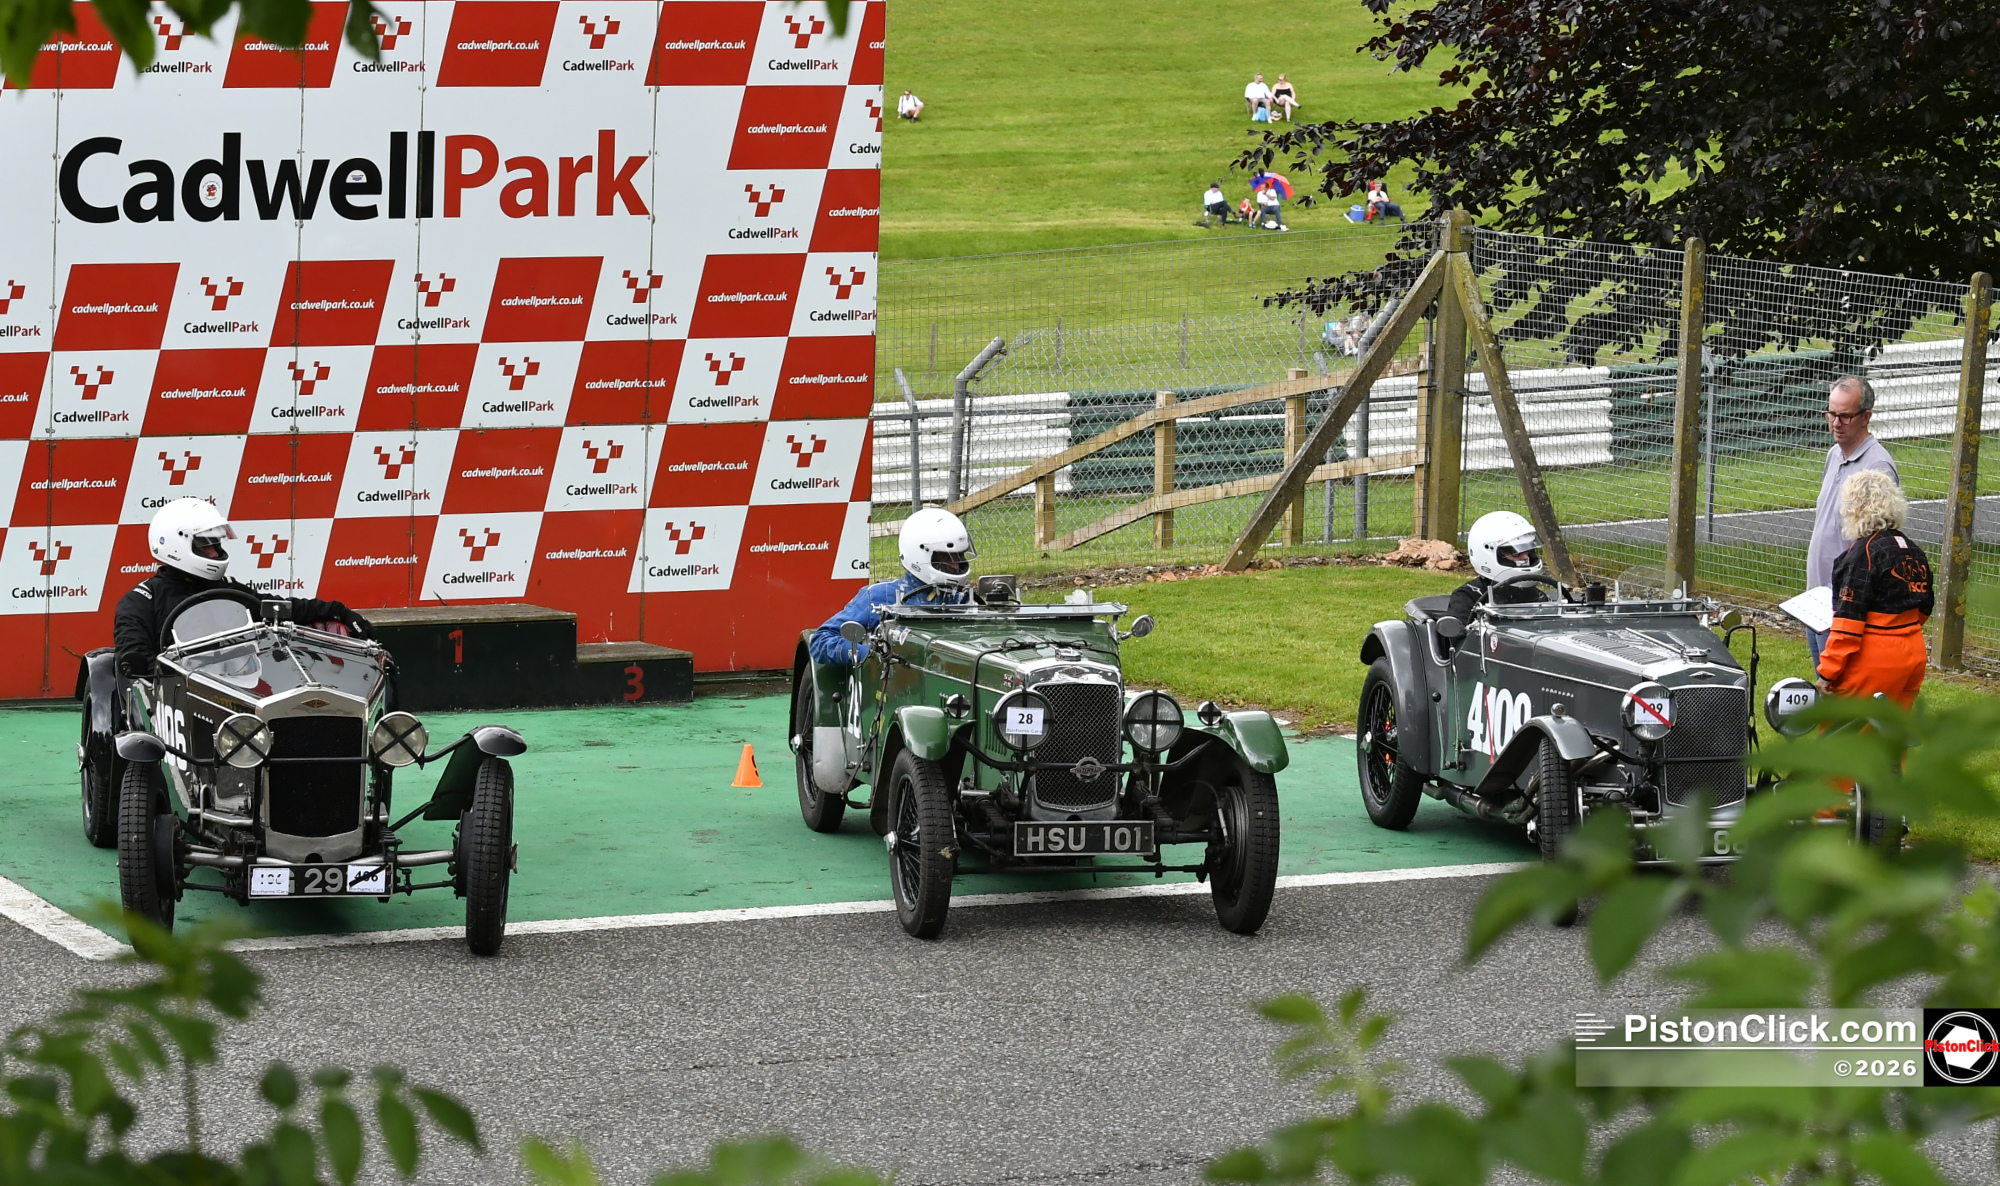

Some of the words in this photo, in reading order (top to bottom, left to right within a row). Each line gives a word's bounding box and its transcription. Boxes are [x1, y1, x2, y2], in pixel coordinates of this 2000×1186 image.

[457, 40, 539, 52] cadwellpark.co.uk
[665, 40, 746, 51] cadwellpark.co.uk
[139, 62, 212, 73] adwellPark
[353, 61, 426, 73] CadwellPark
[563, 60, 634, 71] CadwellPark
[769, 59, 838, 70] CadwellPark
[748, 124, 827, 135] cadwellpark.co.uk
[59, 130, 650, 223] CadwellPark
[729, 227, 798, 239] CadwellPark
[501, 295, 583, 307] cadwellpark.co.uk
[708, 291, 787, 304] cadwellpark.co.uk
[72, 303, 158, 315] cadwellpark.co.uk
[291, 299, 374, 311] cadwellpark.co.uk
[398, 318, 470, 330] CadwellPark
[607, 313, 677, 326] CadwellPark
[184, 321, 258, 333] CadwellPark
[586, 378, 666, 390] cadwellpark.co.uk
[789, 373, 868, 385] cadwellpark.co.uk
[161, 387, 246, 400] cadwellpark.co.uk
[377, 382, 459, 395] cadwellpark.co.uk
[483, 401, 554, 412] CadwellPark
[689, 396, 758, 407] CadwellPark
[53, 410, 129, 423] CadwellPark
[271, 406, 345, 418] CadwellPark
[462, 466, 544, 478] cadwellpark.co.uk
[669, 460, 748, 473] cadwellpark.co.uk
[31, 478, 117, 491] cadwellpark.co.uk
[248, 472, 332, 485] cadwellpark.co.uk
[771, 477, 839, 489] CadwellPark
[567, 483, 637, 495] CadwellPark
[358, 489, 430, 502] CadwellPark
[750, 541, 829, 553] cadwellpark.co.uk
[546, 547, 627, 560] cadwellpark.co.uk
[335, 554, 418, 567] cadwellpark.co.uk
[649, 564, 719, 577] CadwellPark
[443, 571, 514, 584] CadwellPark
[12, 585, 87, 599] CadwellPark
[449, 630, 462, 664] 1
[623, 666, 645, 700] 3
[1786, 694, 1808, 705] 409
[1018, 713, 1033, 724] 28
[1026, 827, 1086, 852] HSU
[1104, 826, 1142, 850] 101
[304, 868, 344, 893] 29
